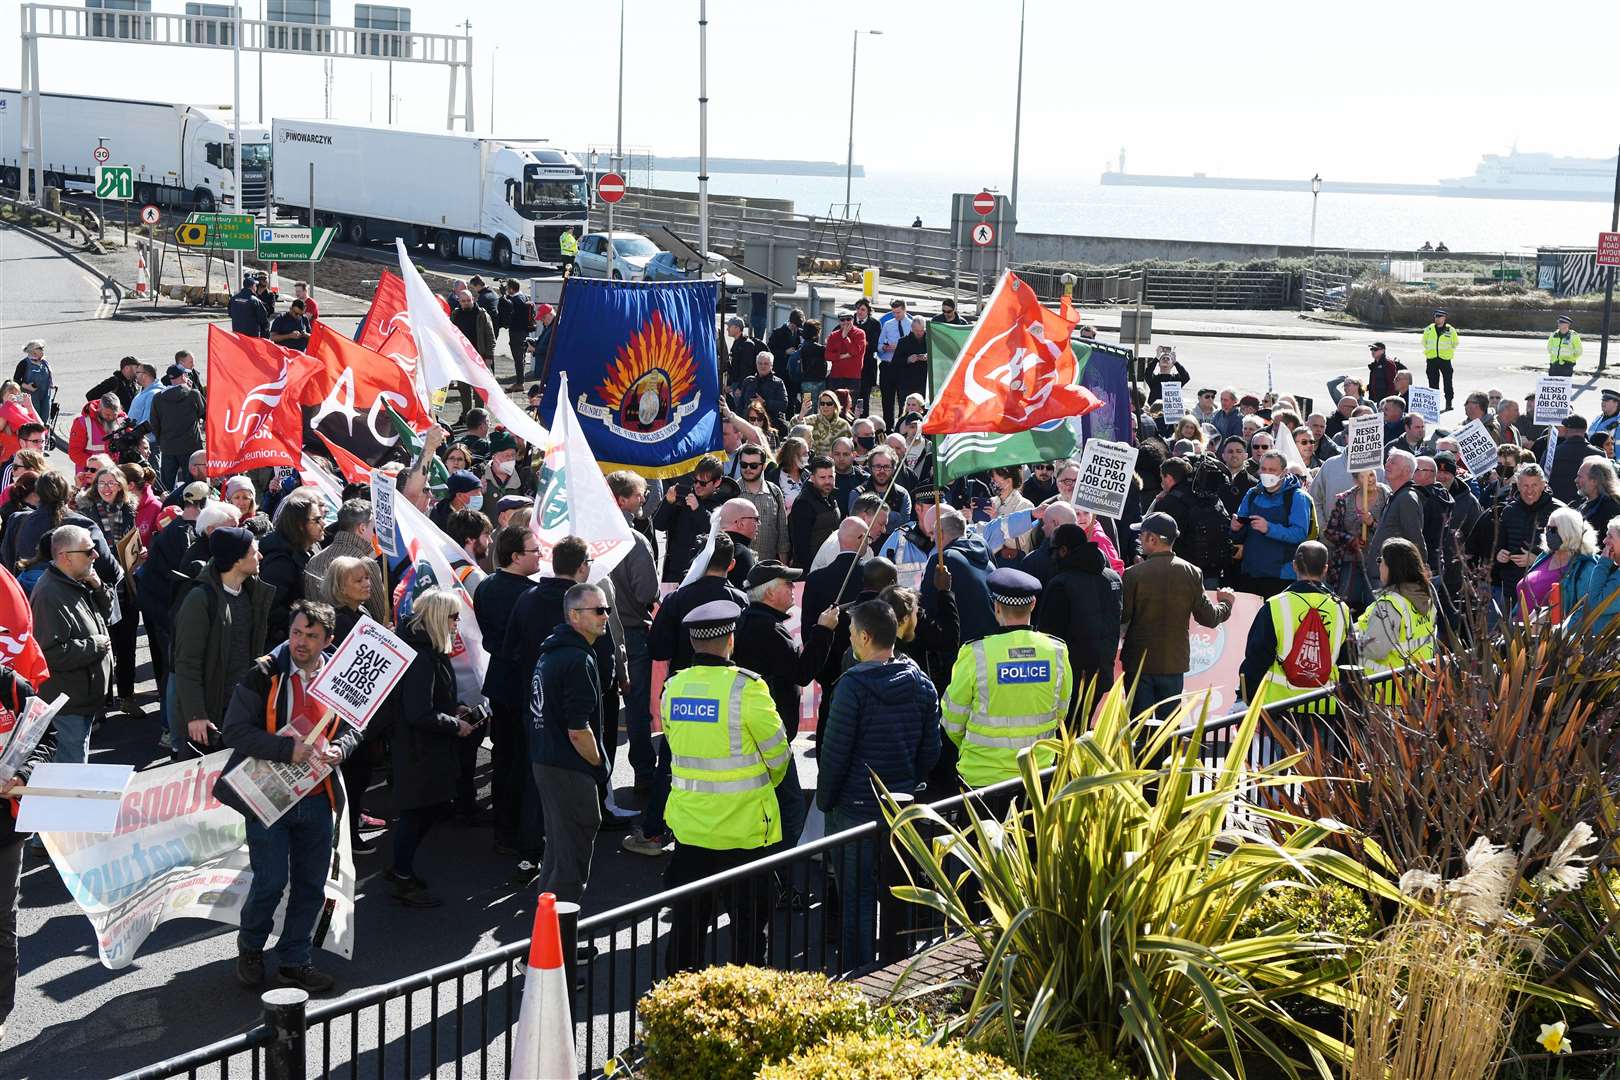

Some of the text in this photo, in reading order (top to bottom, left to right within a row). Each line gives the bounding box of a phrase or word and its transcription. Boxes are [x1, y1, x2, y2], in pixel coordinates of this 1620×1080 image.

[286, 132, 332, 144] PIWOWARCZYK
[579, 402, 602, 417] FOUNDED
[640, 431, 664, 442] BRIGADES
[664, 423, 679, 436] UNION
[1356, 426, 1379, 436] RESIST
[1367, 433, 1380, 442] P&O
[1459, 431, 1481, 447] RESIST
[1351, 442, 1382, 453] JOB CUTS
[1462, 436, 1487, 455] ALL P&O
[1464, 451, 1476, 462] JOB
[1476, 441, 1493, 455] CUTS
[1092, 454, 1126, 470] RESIST
[1086, 465, 1126, 481] ALL P&O
[1080, 474, 1125, 493] JOB CUTS
[369, 627, 398, 649] Socialist
[356, 644, 392, 674] SAVE
[351, 657, 379, 682] P&O
[1001, 667, 1047, 678] POLICE
[339, 668, 375, 695] JOBS
[330, 685, 362, 709] P&O NOW!
[332, 676, 370, 705] NATIONALISE
[673, 704, 715, 716] POLICE
[279, 771, 296, 786] RISE
